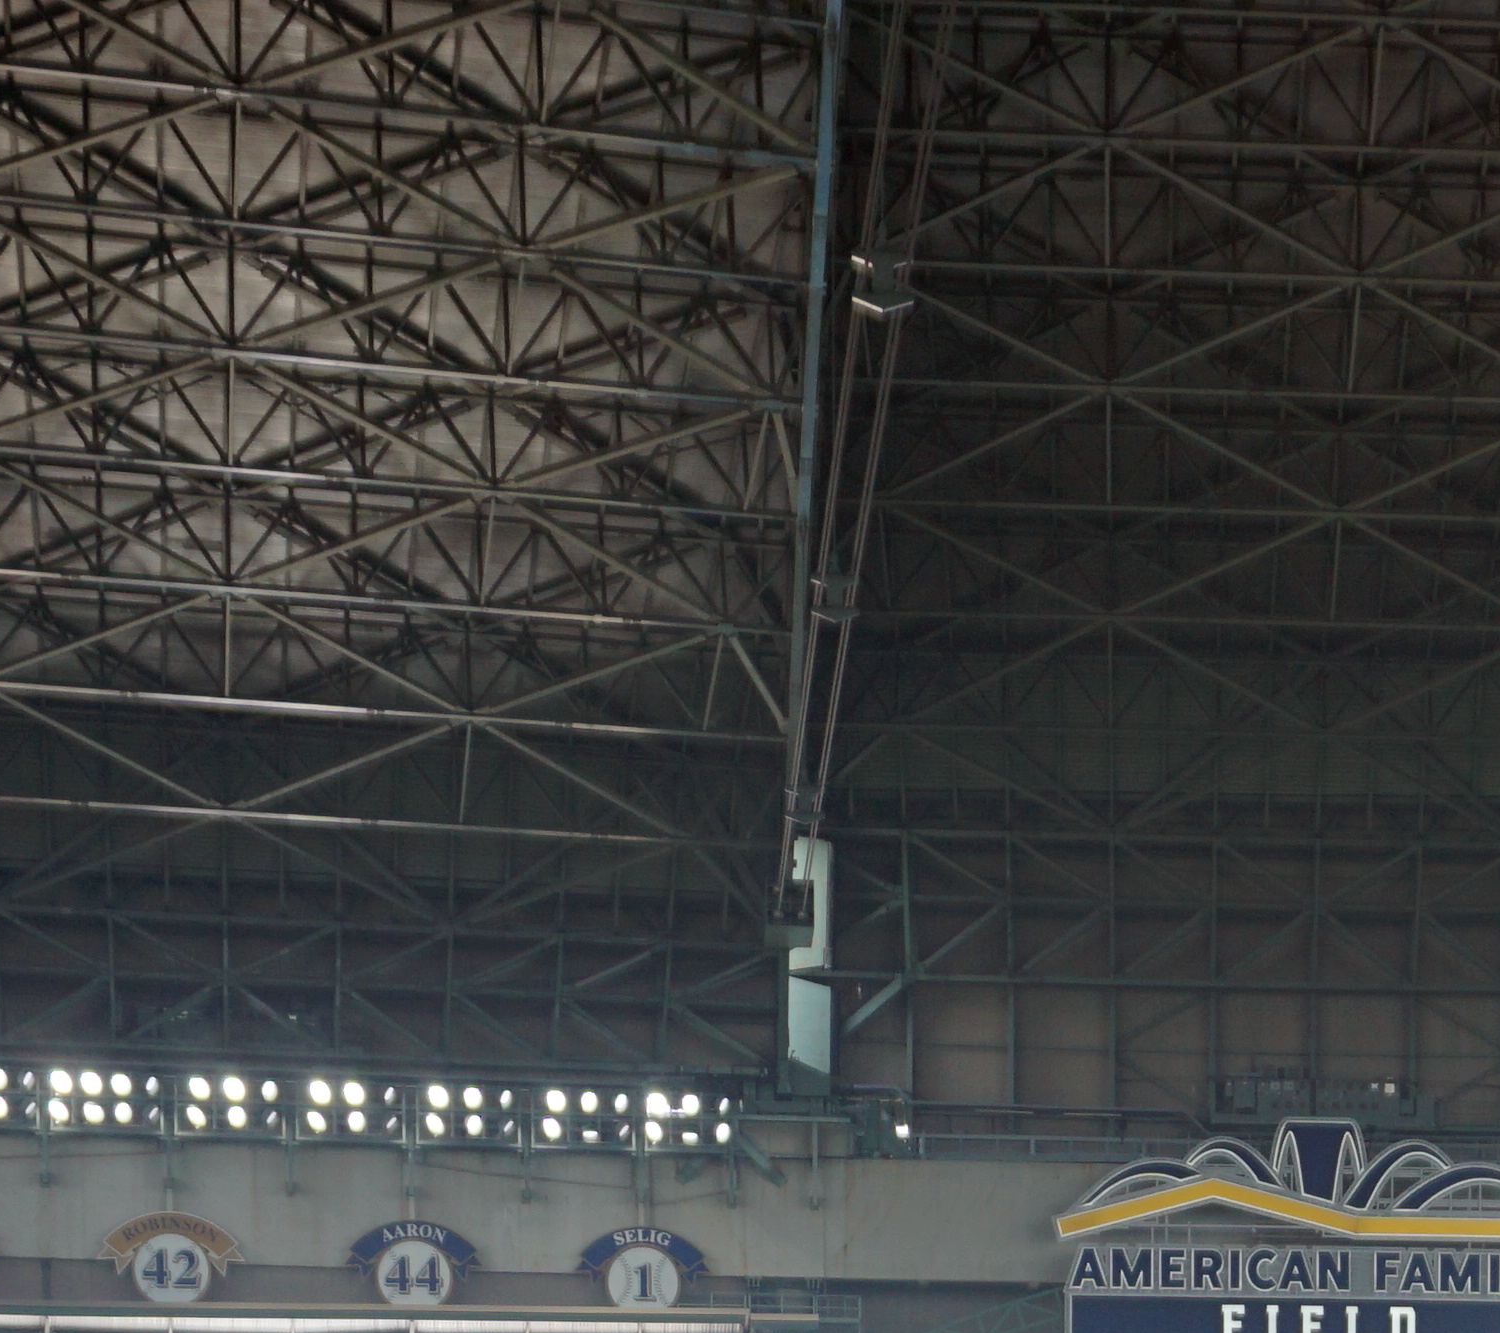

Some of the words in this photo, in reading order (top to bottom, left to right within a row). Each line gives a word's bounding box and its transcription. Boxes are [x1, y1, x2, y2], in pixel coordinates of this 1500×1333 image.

[119, 1213, 222, 1245] ROBINSON
[379, 1220, 448, 1242] AARON
[611, 1228, 672, 1250] SELIG
[141, 1245, 202, 1290] 42
[384, 1253, 443, 1296] 44
[631, 1261, 659, 1300] 1
[1071, 1247, 1353, 1292] AMERICAN
